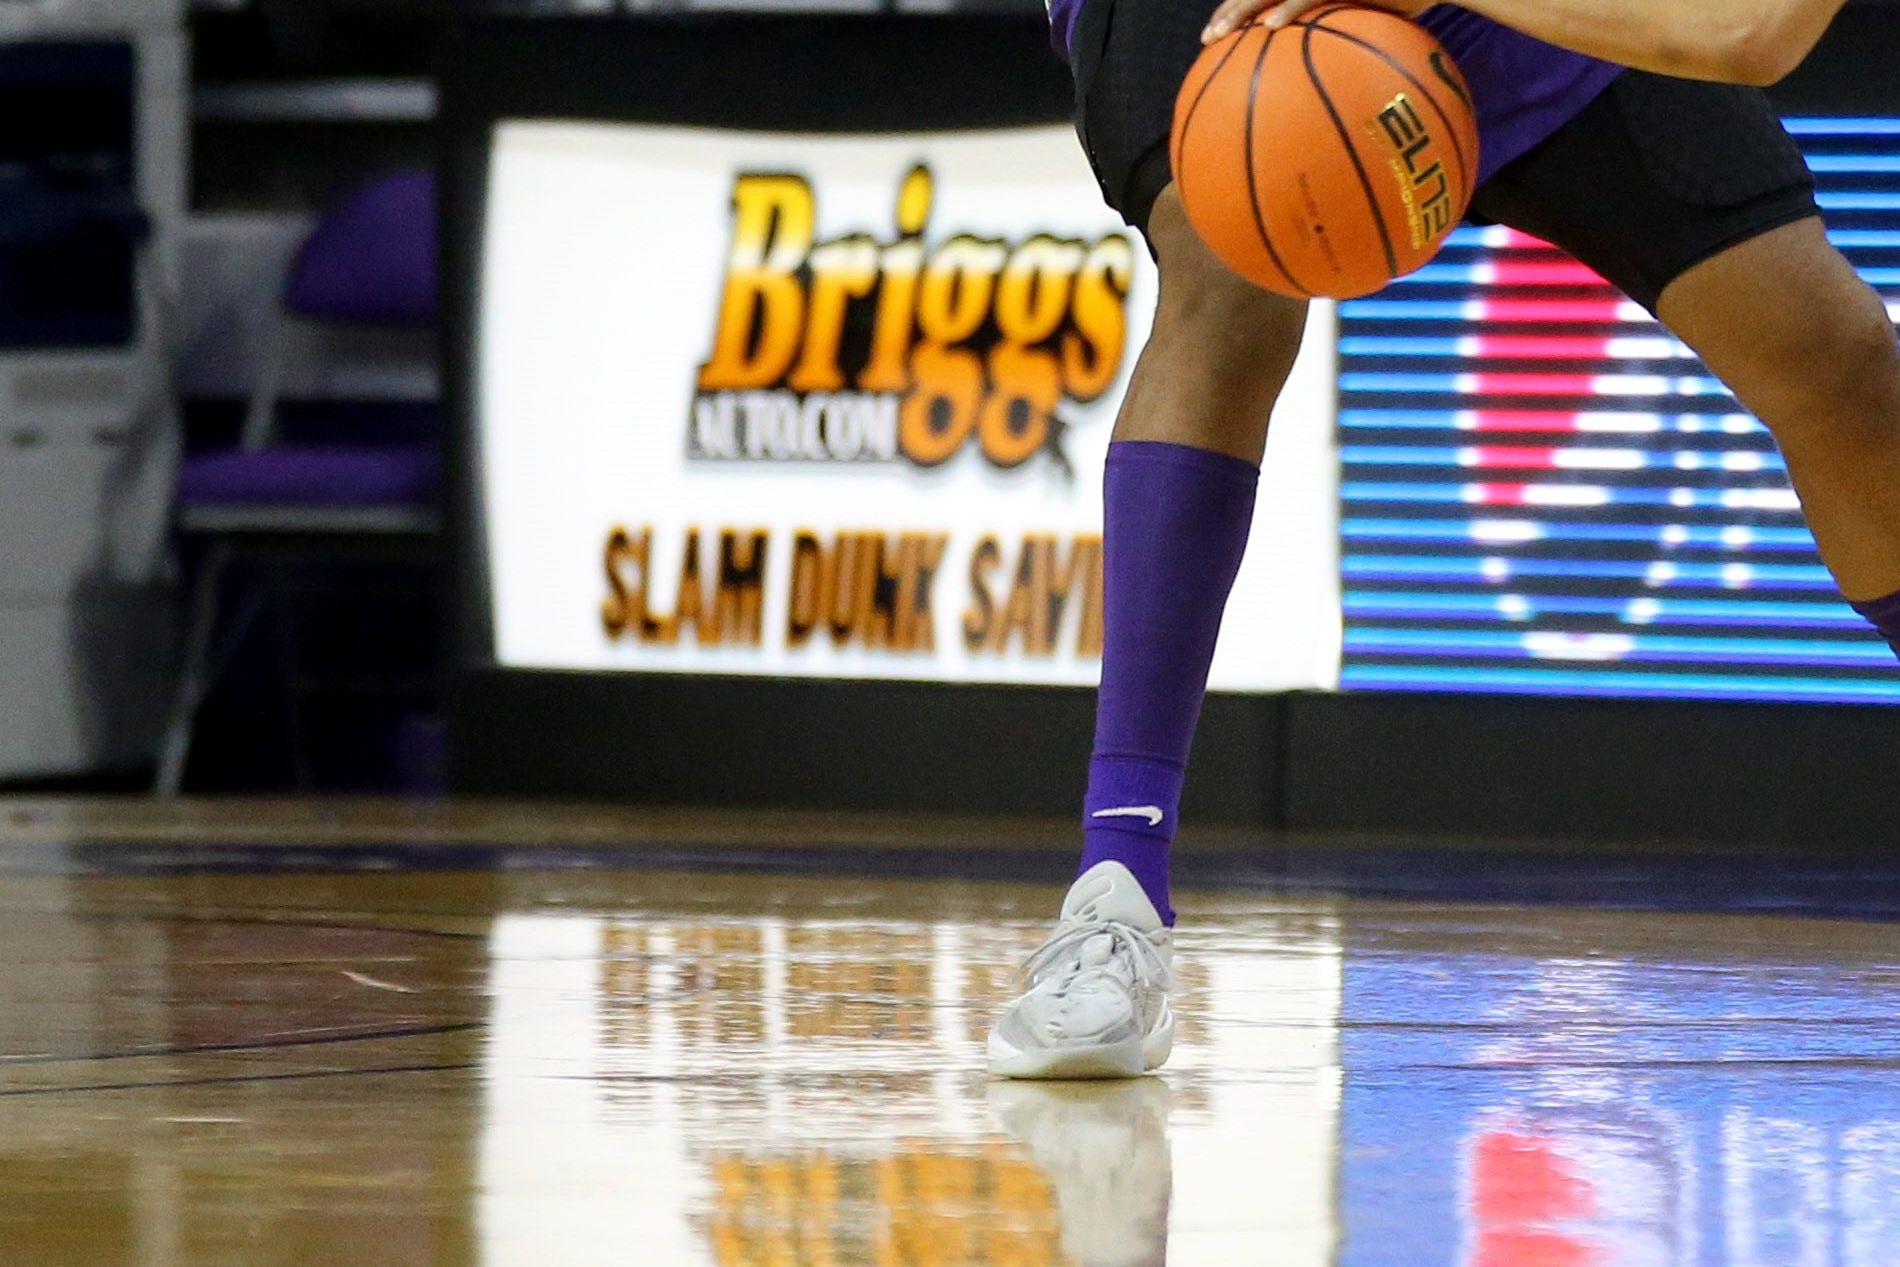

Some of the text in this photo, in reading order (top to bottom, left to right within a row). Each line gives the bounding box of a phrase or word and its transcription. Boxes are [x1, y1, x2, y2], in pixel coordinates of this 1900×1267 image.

[1378, 93, 1450, 242] ELITE
[694, 162, 1133, 467] Briggs
[600, 524, 1104, 660] SLAM DUNK SAVI
